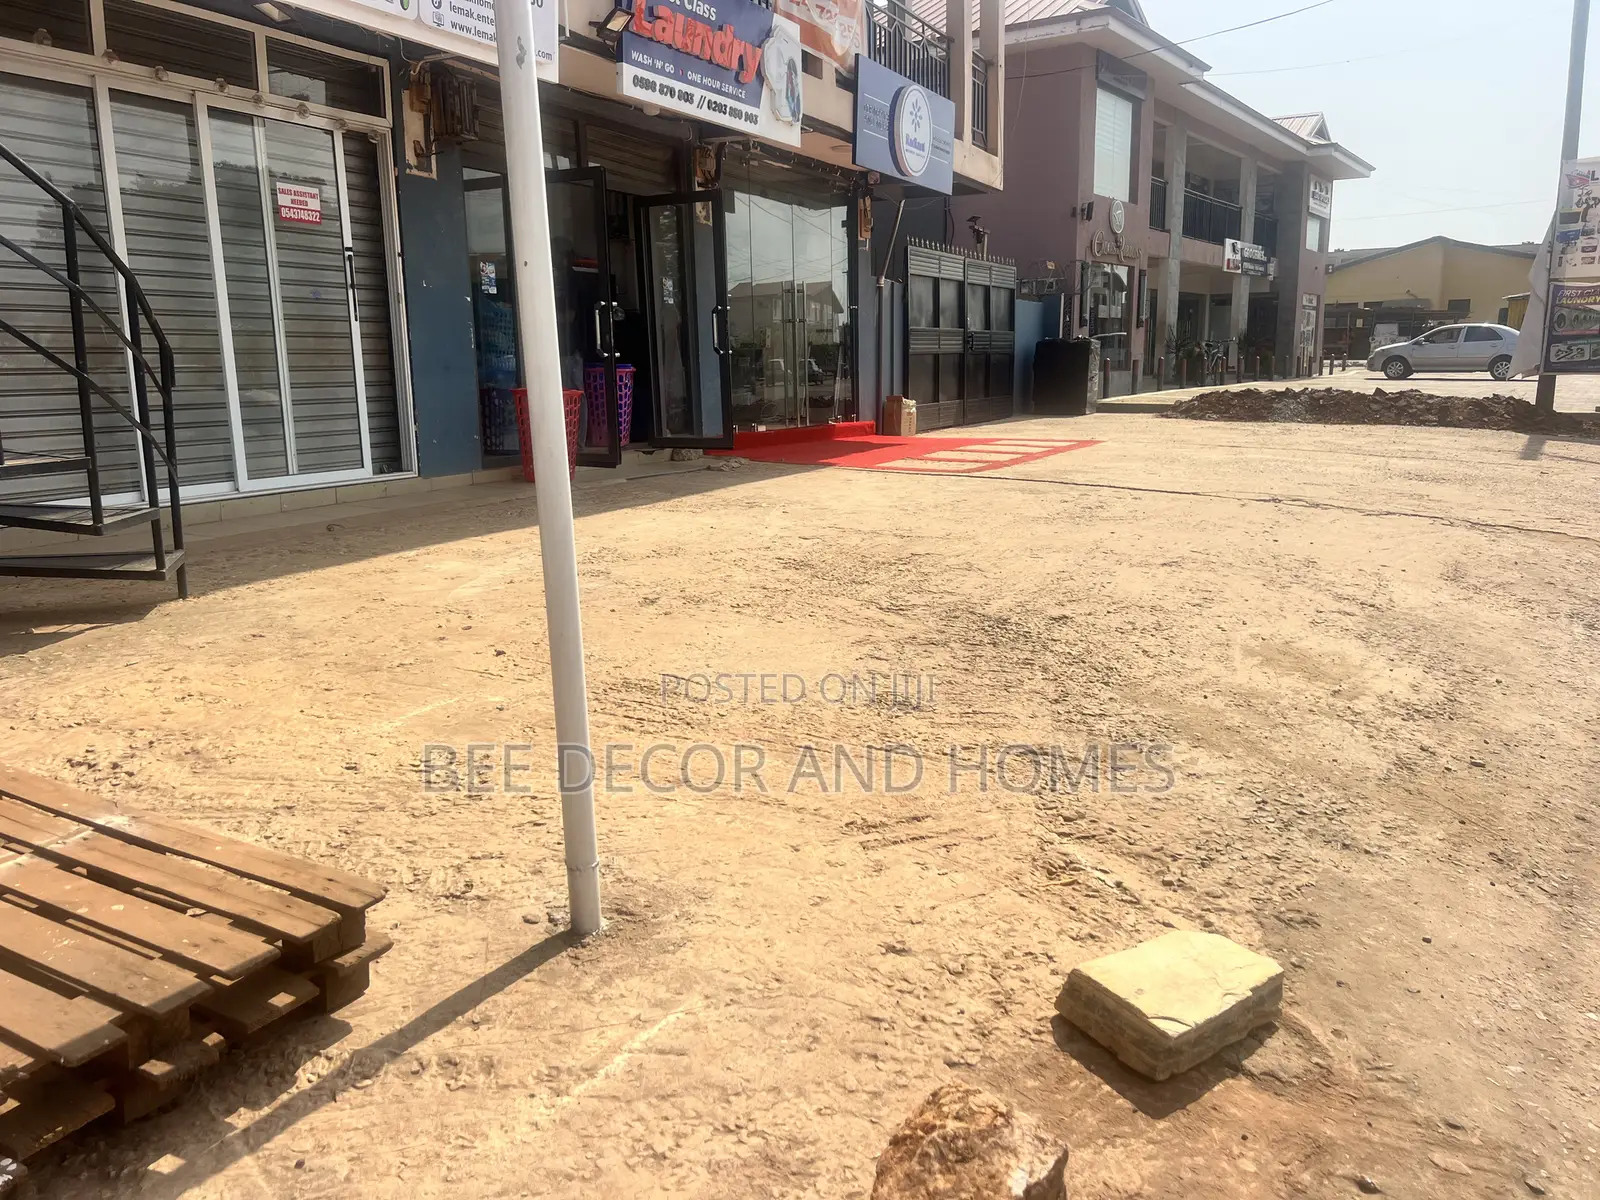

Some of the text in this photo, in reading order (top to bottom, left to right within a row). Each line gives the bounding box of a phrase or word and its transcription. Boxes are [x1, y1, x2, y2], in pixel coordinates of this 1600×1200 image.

[684, 0, 717, 21] Class
[632, 0, 763, 84] Laundry
[631, 50, 653, 65] WASH
[665, 62, 675, 74] GO
[687, 71, 702, 83] ONE
[703, 77, 721, 90] HOUR
[721, 83, 747, 99] SERVICE
[707, 99, 728, 115] 0203
[278, 187, 319, 200] SALES ASSISTANT
[1557, 289, 1581, 297] FIRST
